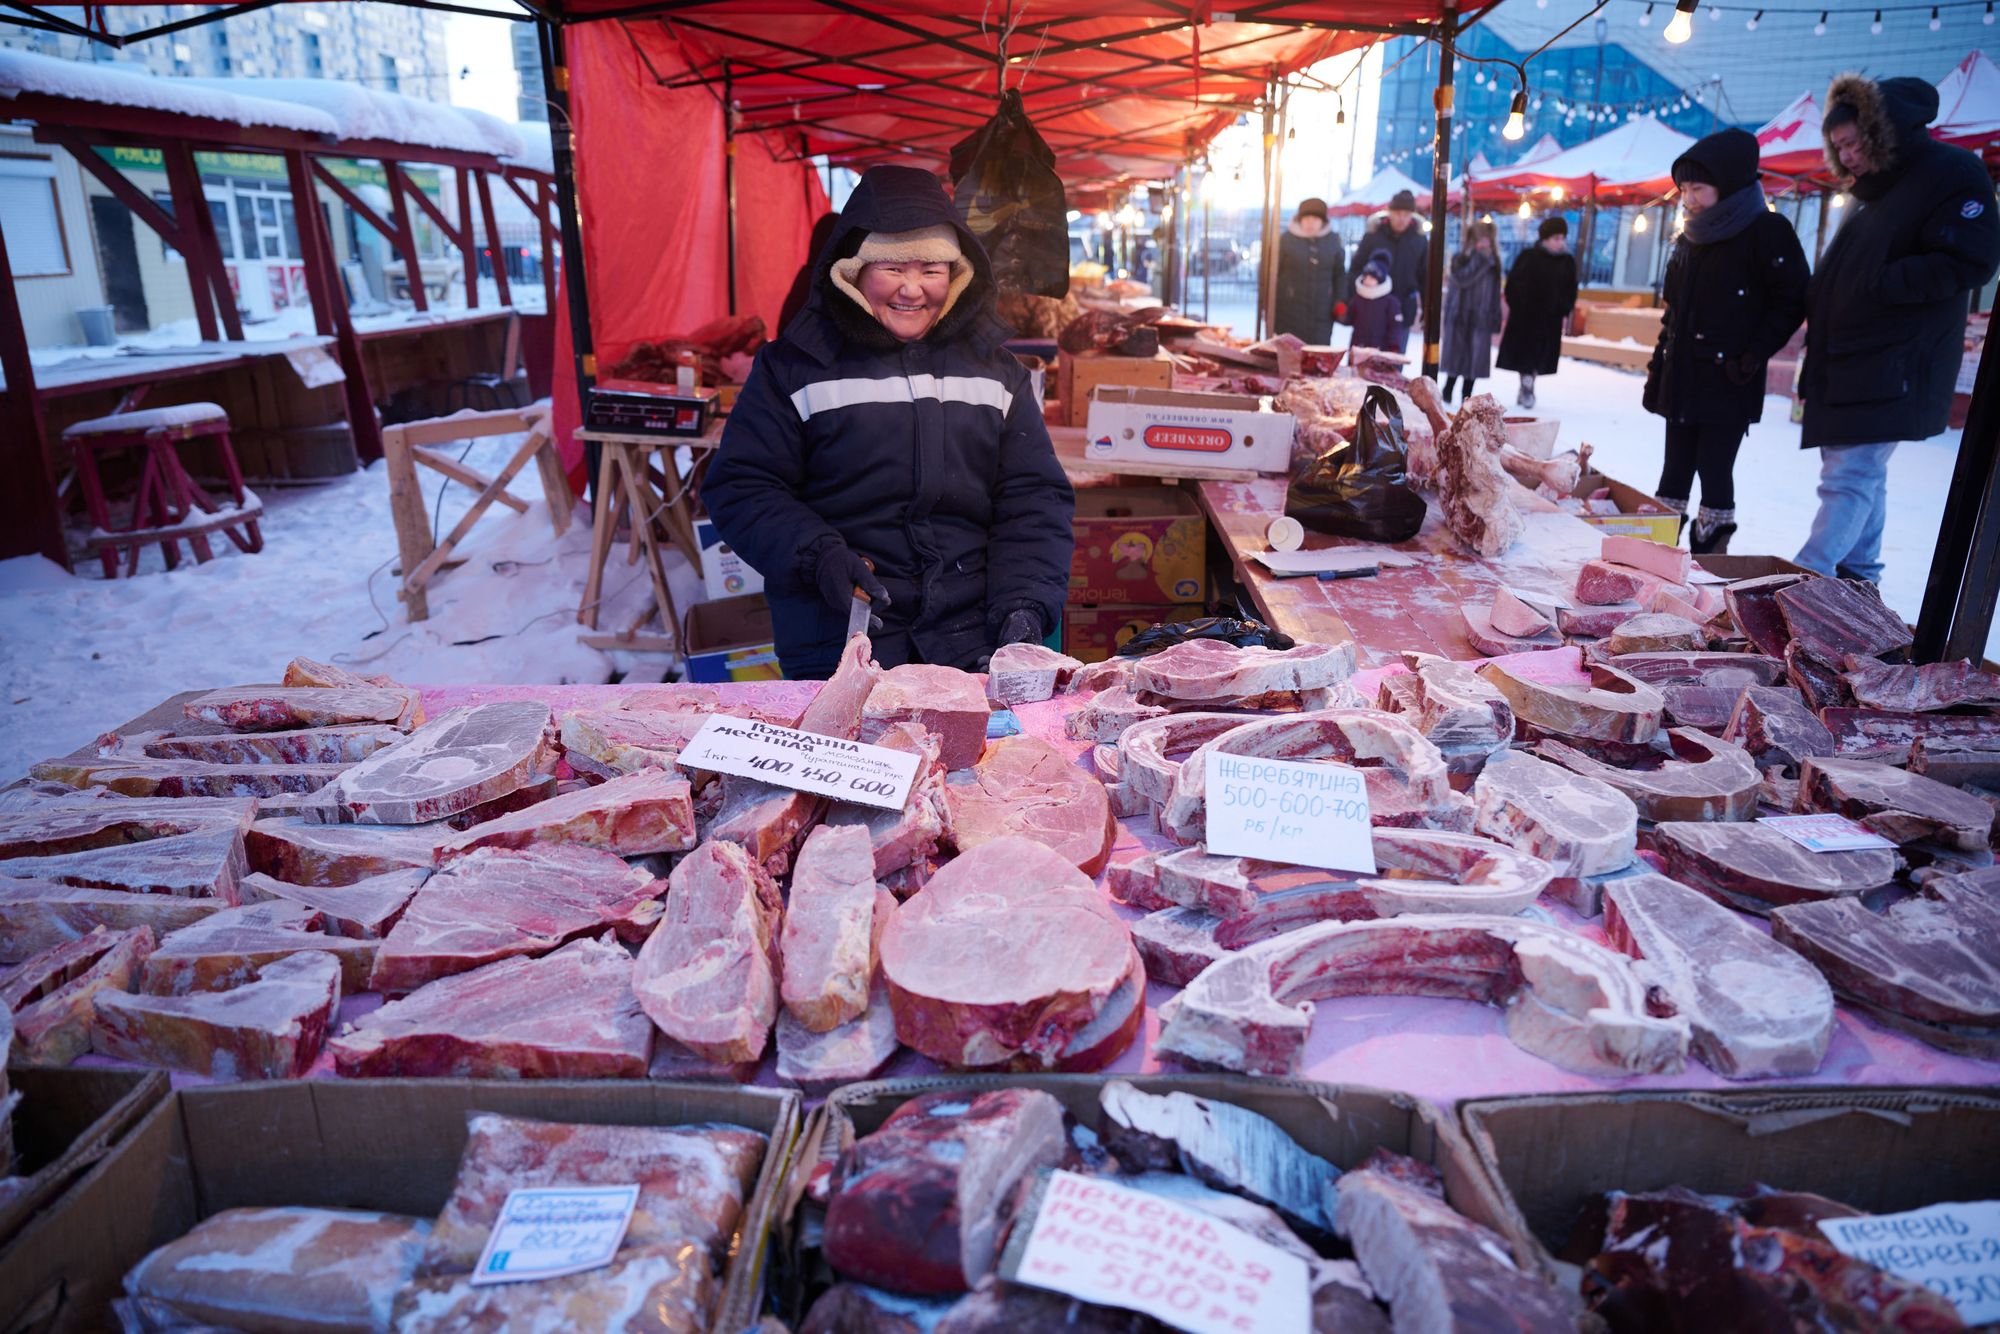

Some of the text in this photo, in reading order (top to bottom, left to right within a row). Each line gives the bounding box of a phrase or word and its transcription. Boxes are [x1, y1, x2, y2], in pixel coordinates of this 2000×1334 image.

[1152, 431, 1225, 447] ORENBEEF
[750, 722, 859, 752] ГОВЯДИНА
[1223, 784, 1368, 823] 500-600-700
[1094, 1262, 1201, 1311] 500
